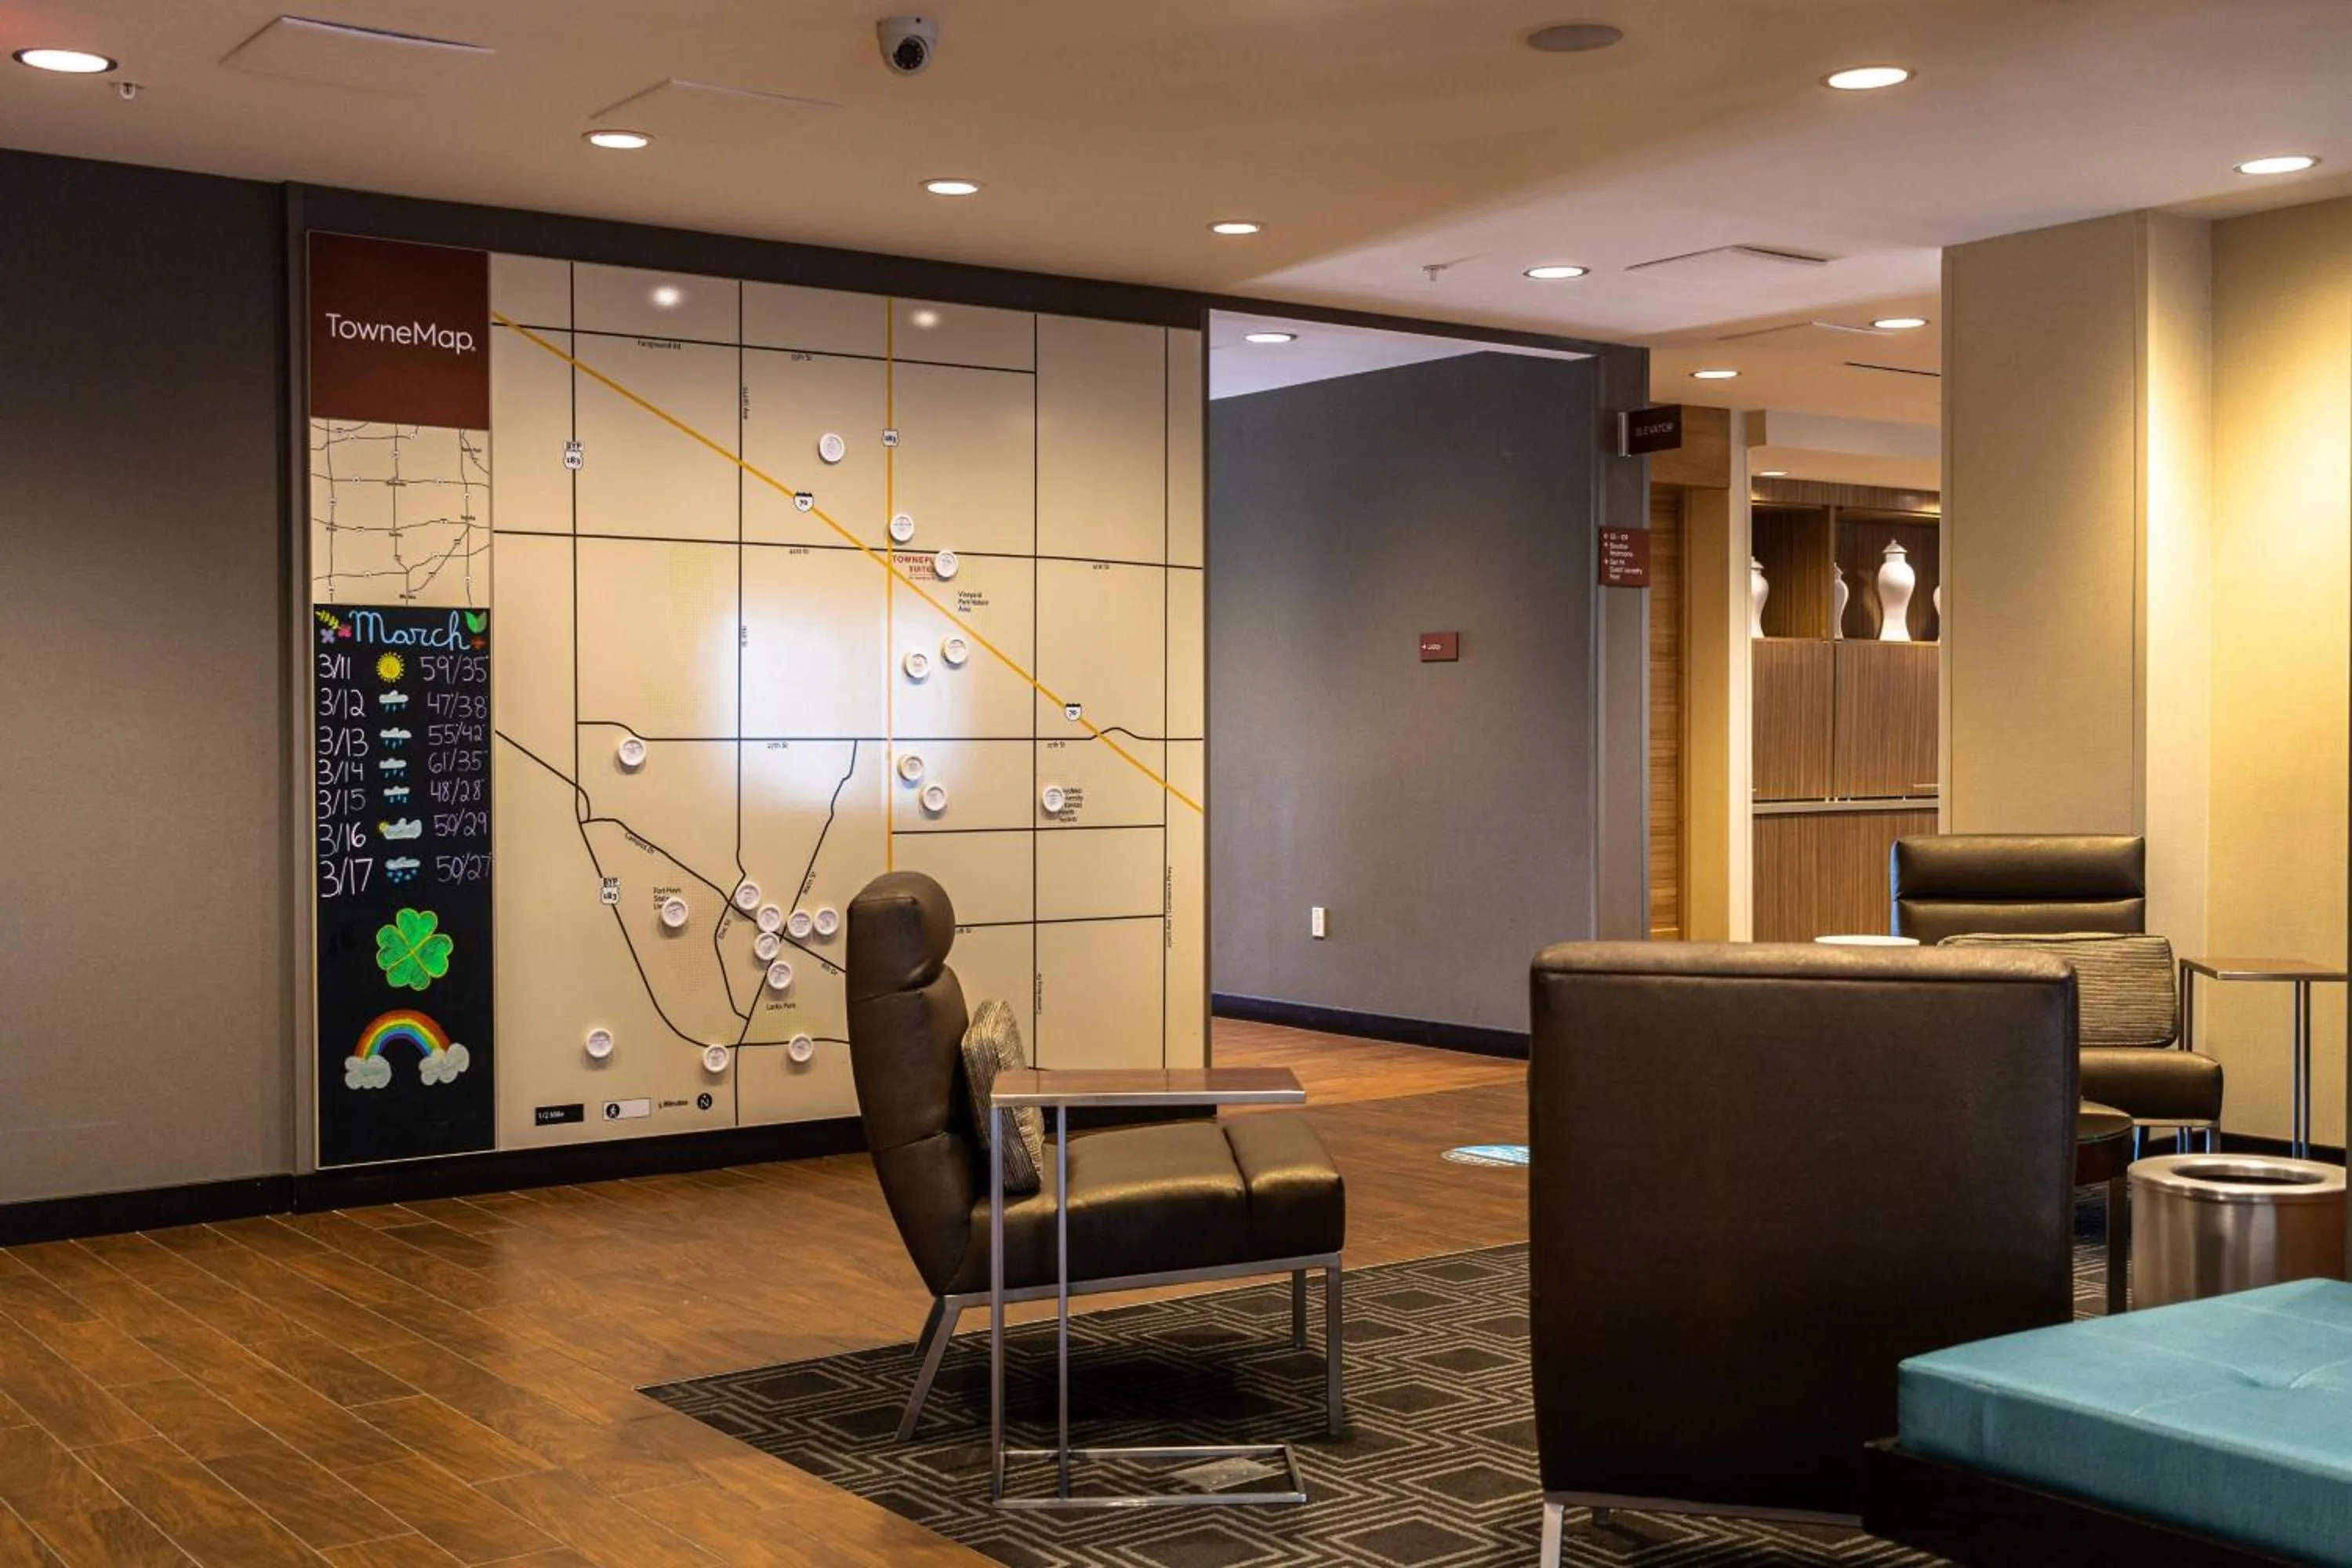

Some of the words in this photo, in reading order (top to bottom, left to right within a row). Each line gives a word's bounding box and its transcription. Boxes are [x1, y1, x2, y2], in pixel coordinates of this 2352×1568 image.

[348, 609, 471, 651] March
[318, 653, 351, 681] 3/11
[318, 688, 366, 720] 3/12
[318, 725, 369, 757] 3/13
[318, 758, 364, 785] 3/14
[318, 788, 366, 819] 3/15
[318, 822, 366, 857] 3/16
[318, 856, 373, 898] 3/17
[602, 877, 619, 887] BYP
[603, 891, 618, 901] 183
